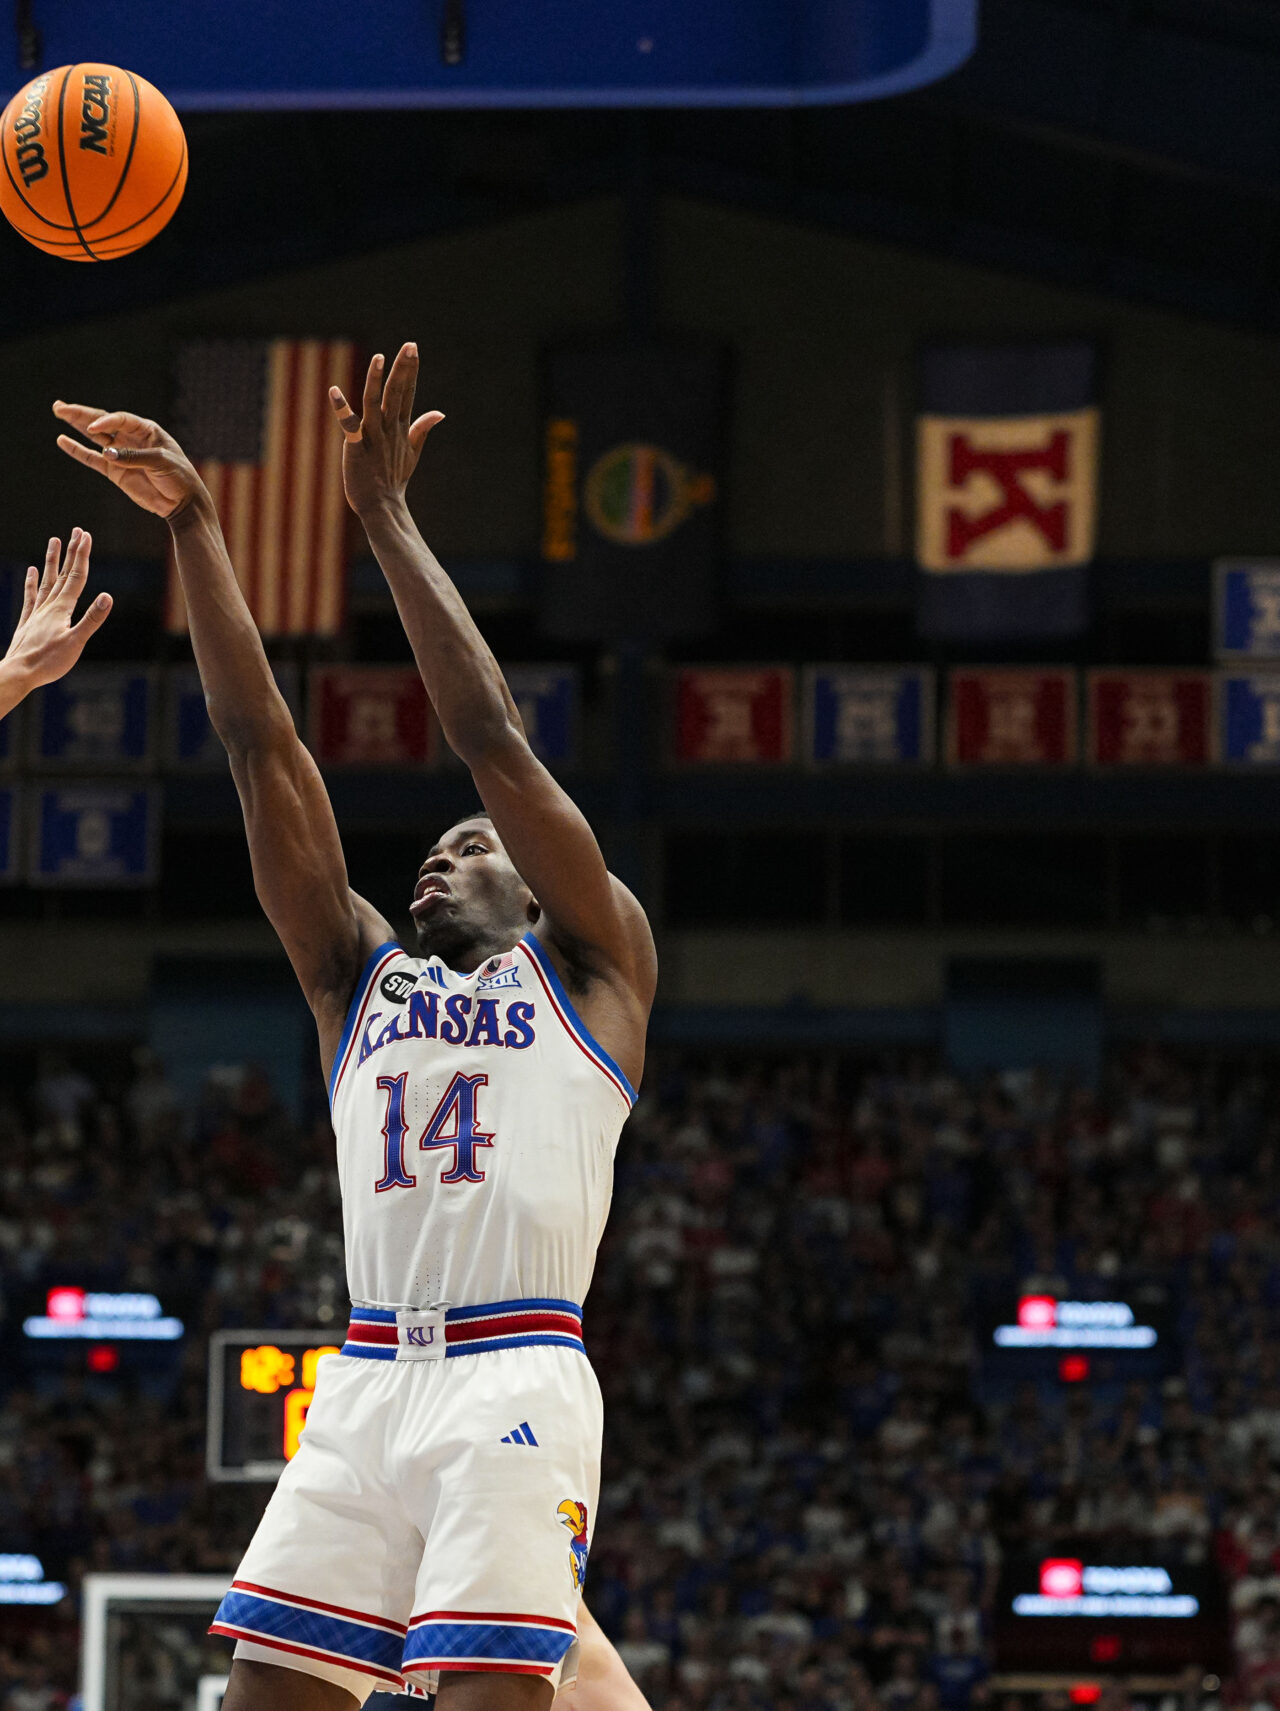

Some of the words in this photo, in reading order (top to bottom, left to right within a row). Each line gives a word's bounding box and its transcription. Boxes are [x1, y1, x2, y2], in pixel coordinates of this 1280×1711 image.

[80, 75, 112, 156] NCAA
[950, 431, 1068, 559] K
[357, 991, 536, 1069] KANSAS
[374, 1071, 496, 1193] 14
[406, 1326, 434, 1346] KU
